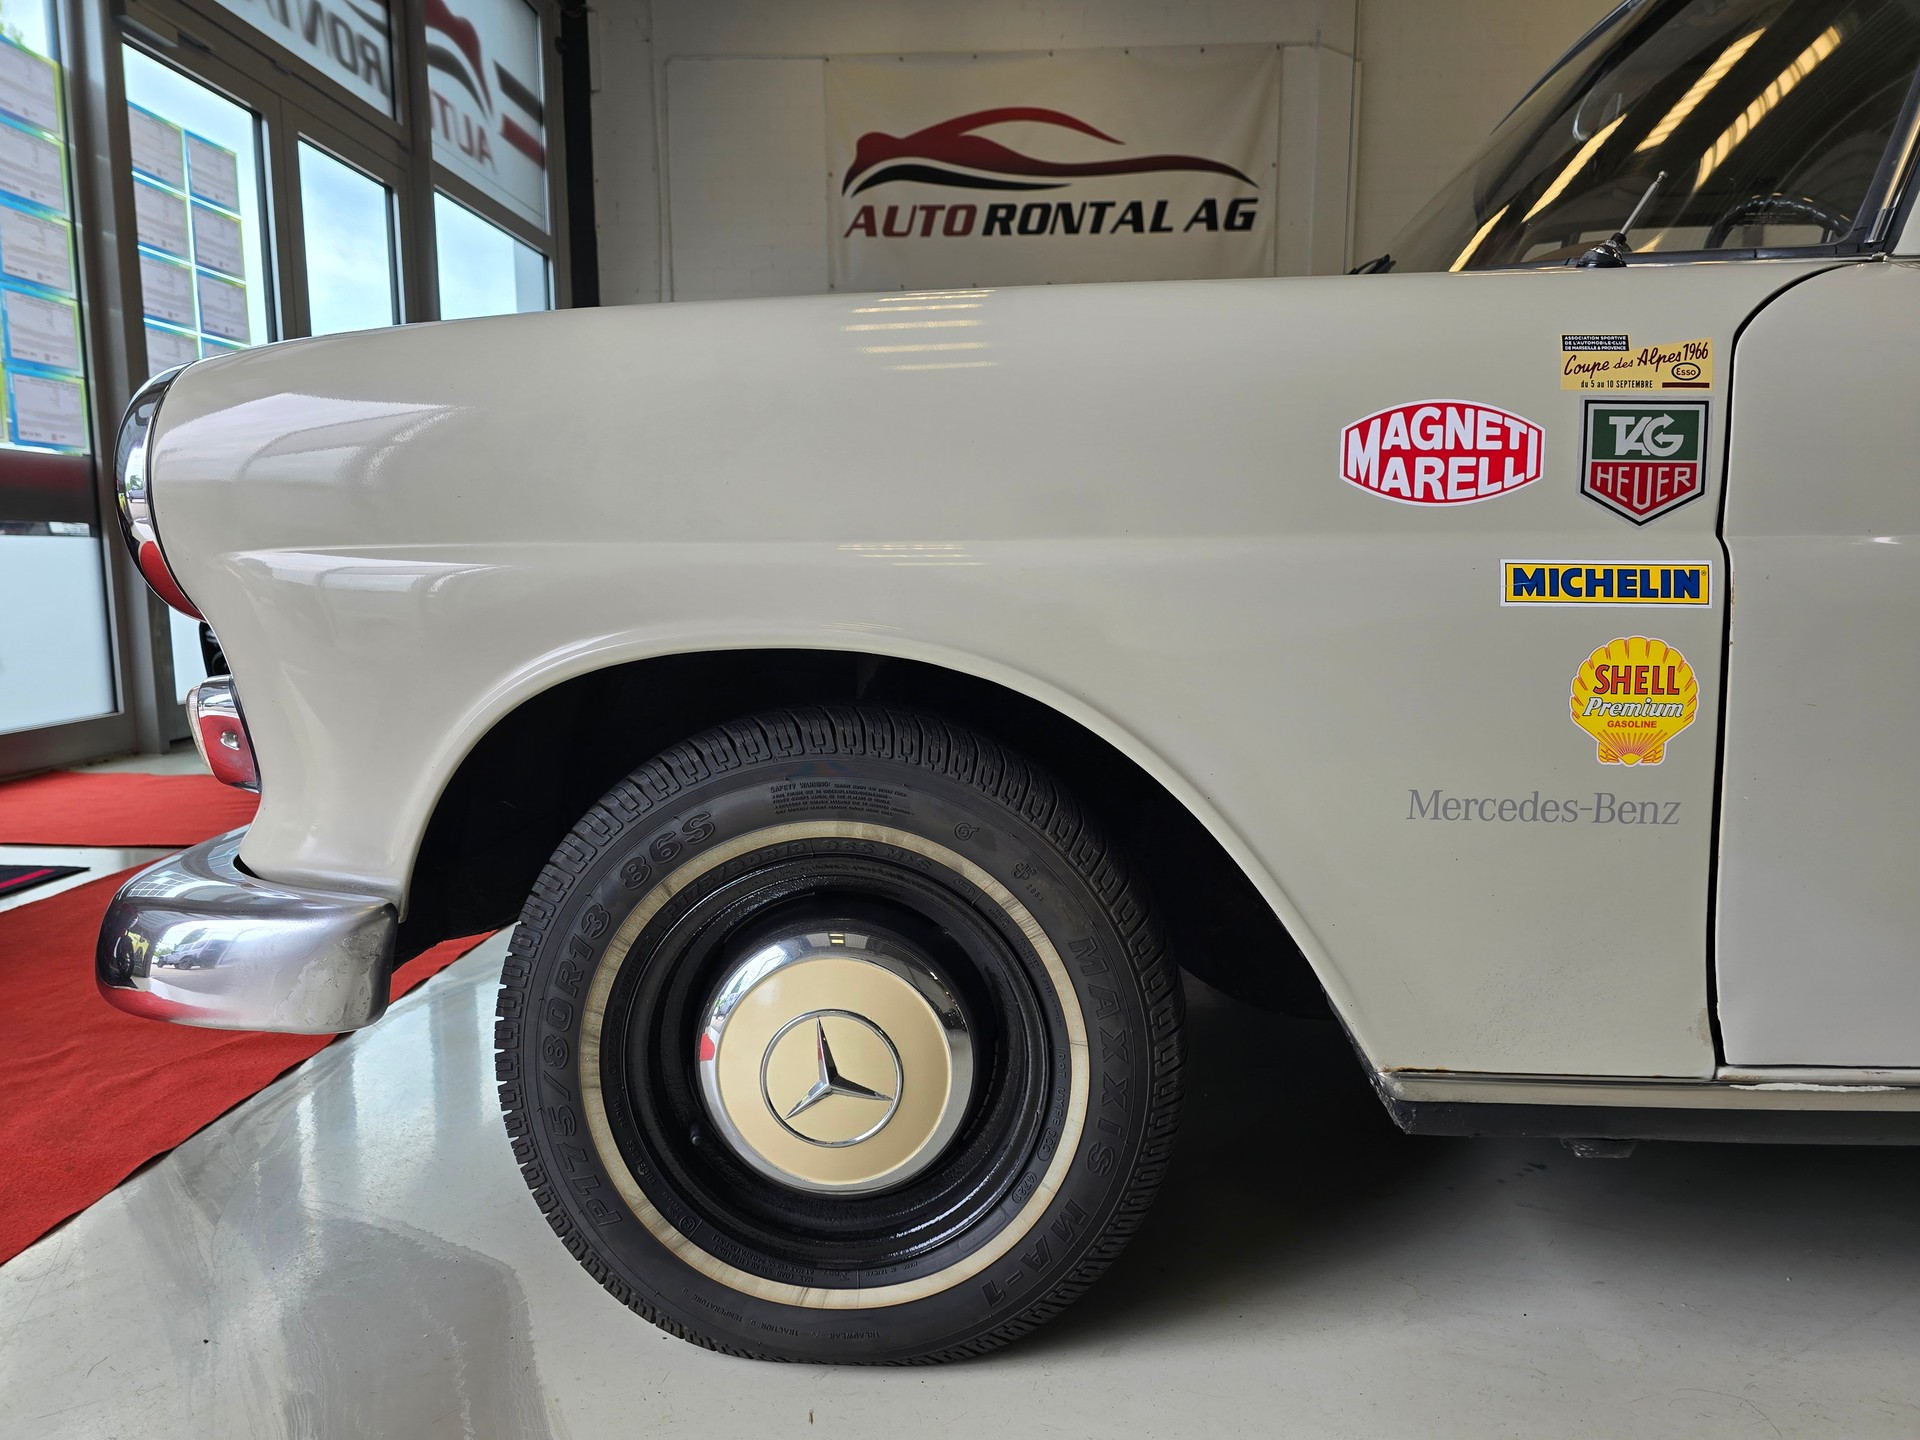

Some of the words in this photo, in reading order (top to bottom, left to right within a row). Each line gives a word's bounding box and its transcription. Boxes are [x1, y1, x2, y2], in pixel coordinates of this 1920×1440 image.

[844, 204, 977, 238] AUTO
[982, 201, 1174, 236] RONTAL
[1183, 198, 1258, 232] AG
[1564, 355, 1609, 379] Coupe
[1613, 357, 1633, 369] des
[1637, 347, 1681, 372] Alpes
[1683, 342, 1708, 360] 1966
[1581, 380, 1588, 388] du
[1591, 380, 1595, 388] 5
[1597, 380, 1604, 388] au
[1607, 380, 1614, 388] 10
[1616, 380, 1653, 388] SEPTEMBRE
[1348, 406, 1538, 487] MAGNETI
[1609, 413, 1684, 456] TAG
[1348, 420, 1538, 500] MARELLI
[1596, 466, 1691, 511] HEUER
[1512, 567, 1700, 598] MICHELIN
[1593, 664, 1680, 695] SHELL
[1582, 697, 1684, 717] Premium
[1607, 720, 1657, 729] GASOLINE
[1406, 788, 1681, 826] Mercedes-Benz
[543, 902, 622, 1226] P175/80R13
[619, 811, 716, 892] 86S
[1057, 1053, 1066, 1078] DOT
[1068, 936, 1128, 1176] MAXXIS
[1013, 1176, 1036, 1202] 4721
[981, 1199, 1088, 1306] MA-1
